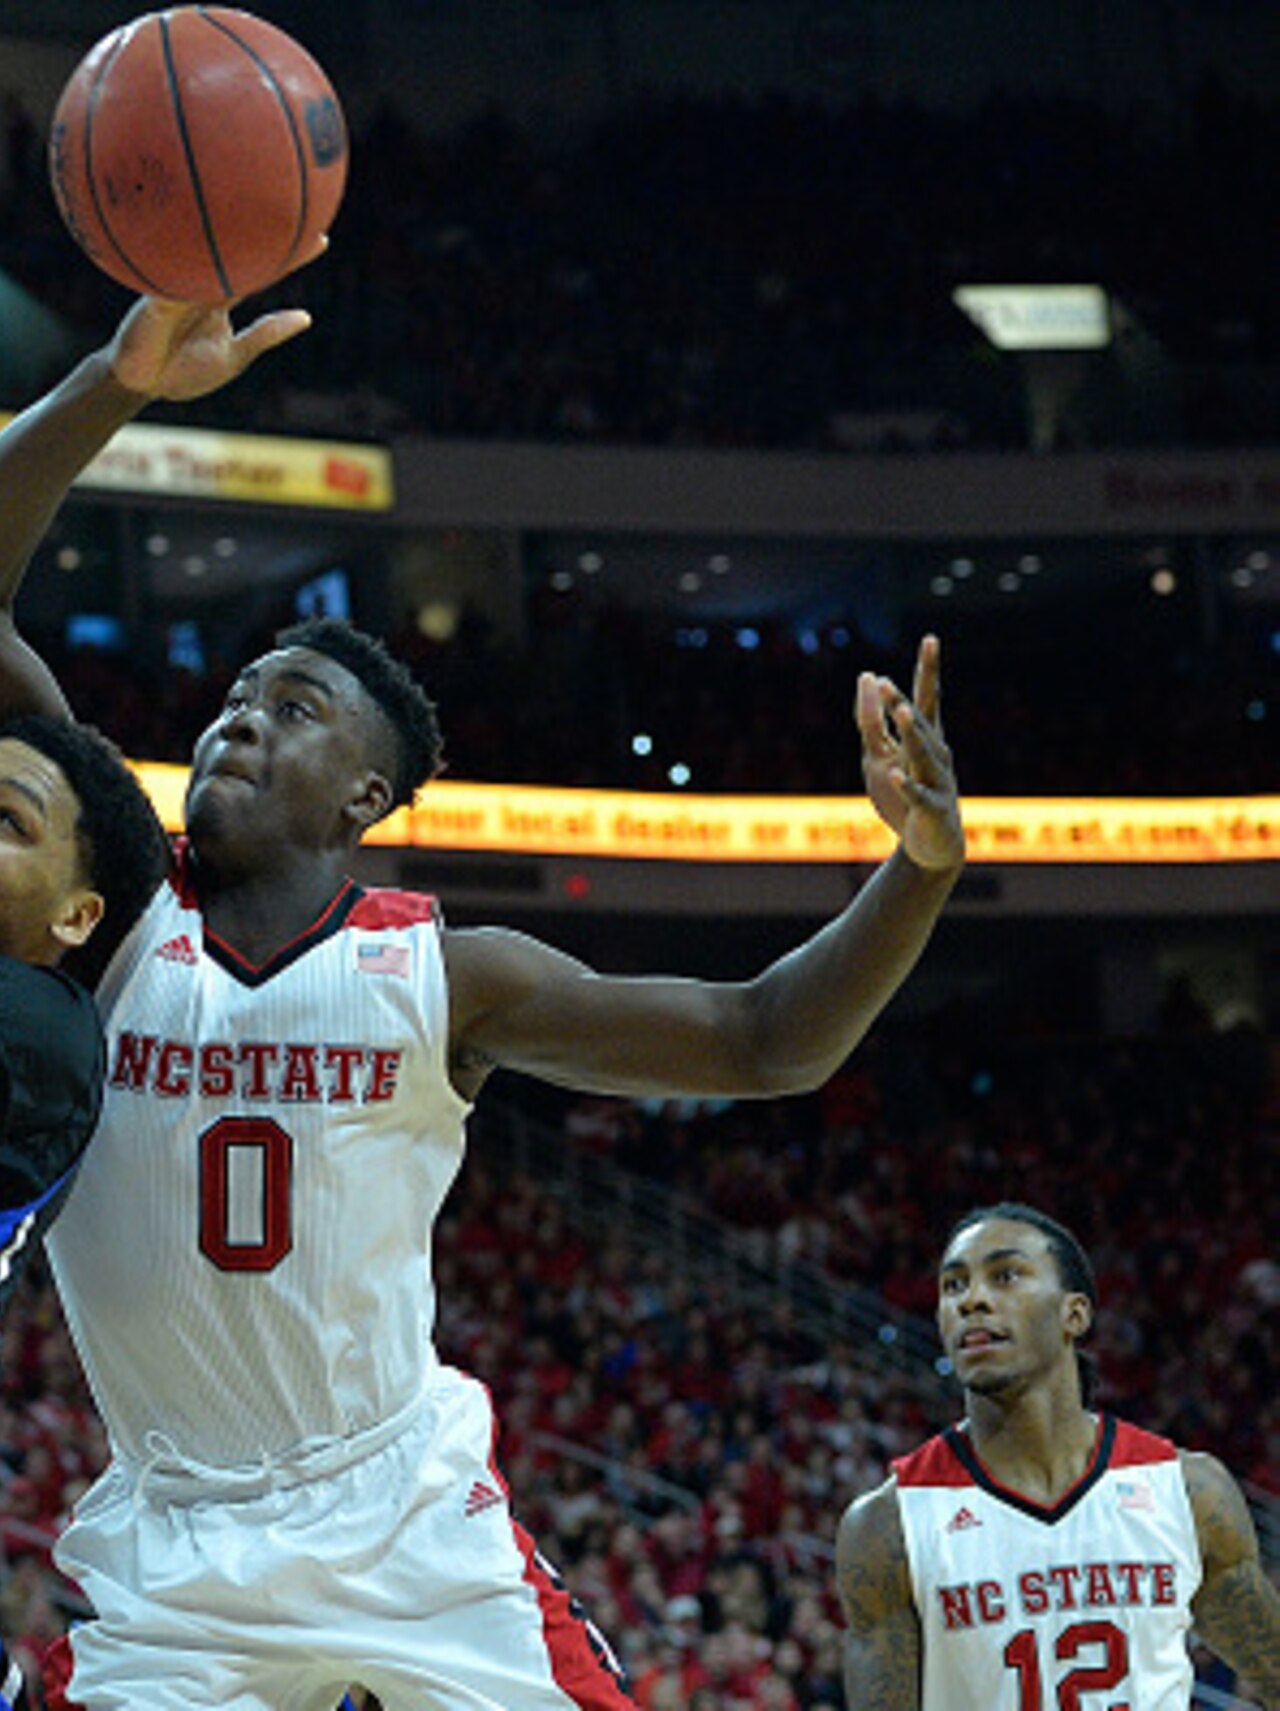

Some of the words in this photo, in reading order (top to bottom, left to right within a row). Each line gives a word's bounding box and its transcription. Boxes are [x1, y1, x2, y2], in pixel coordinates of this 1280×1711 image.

[198, 1116, 293, 1273] 0
[937, 1575, 1007, 1632] NC
[1017, 1562, 1178, 1614] STATE
[1003, 1620, 1130, 1711] 12
